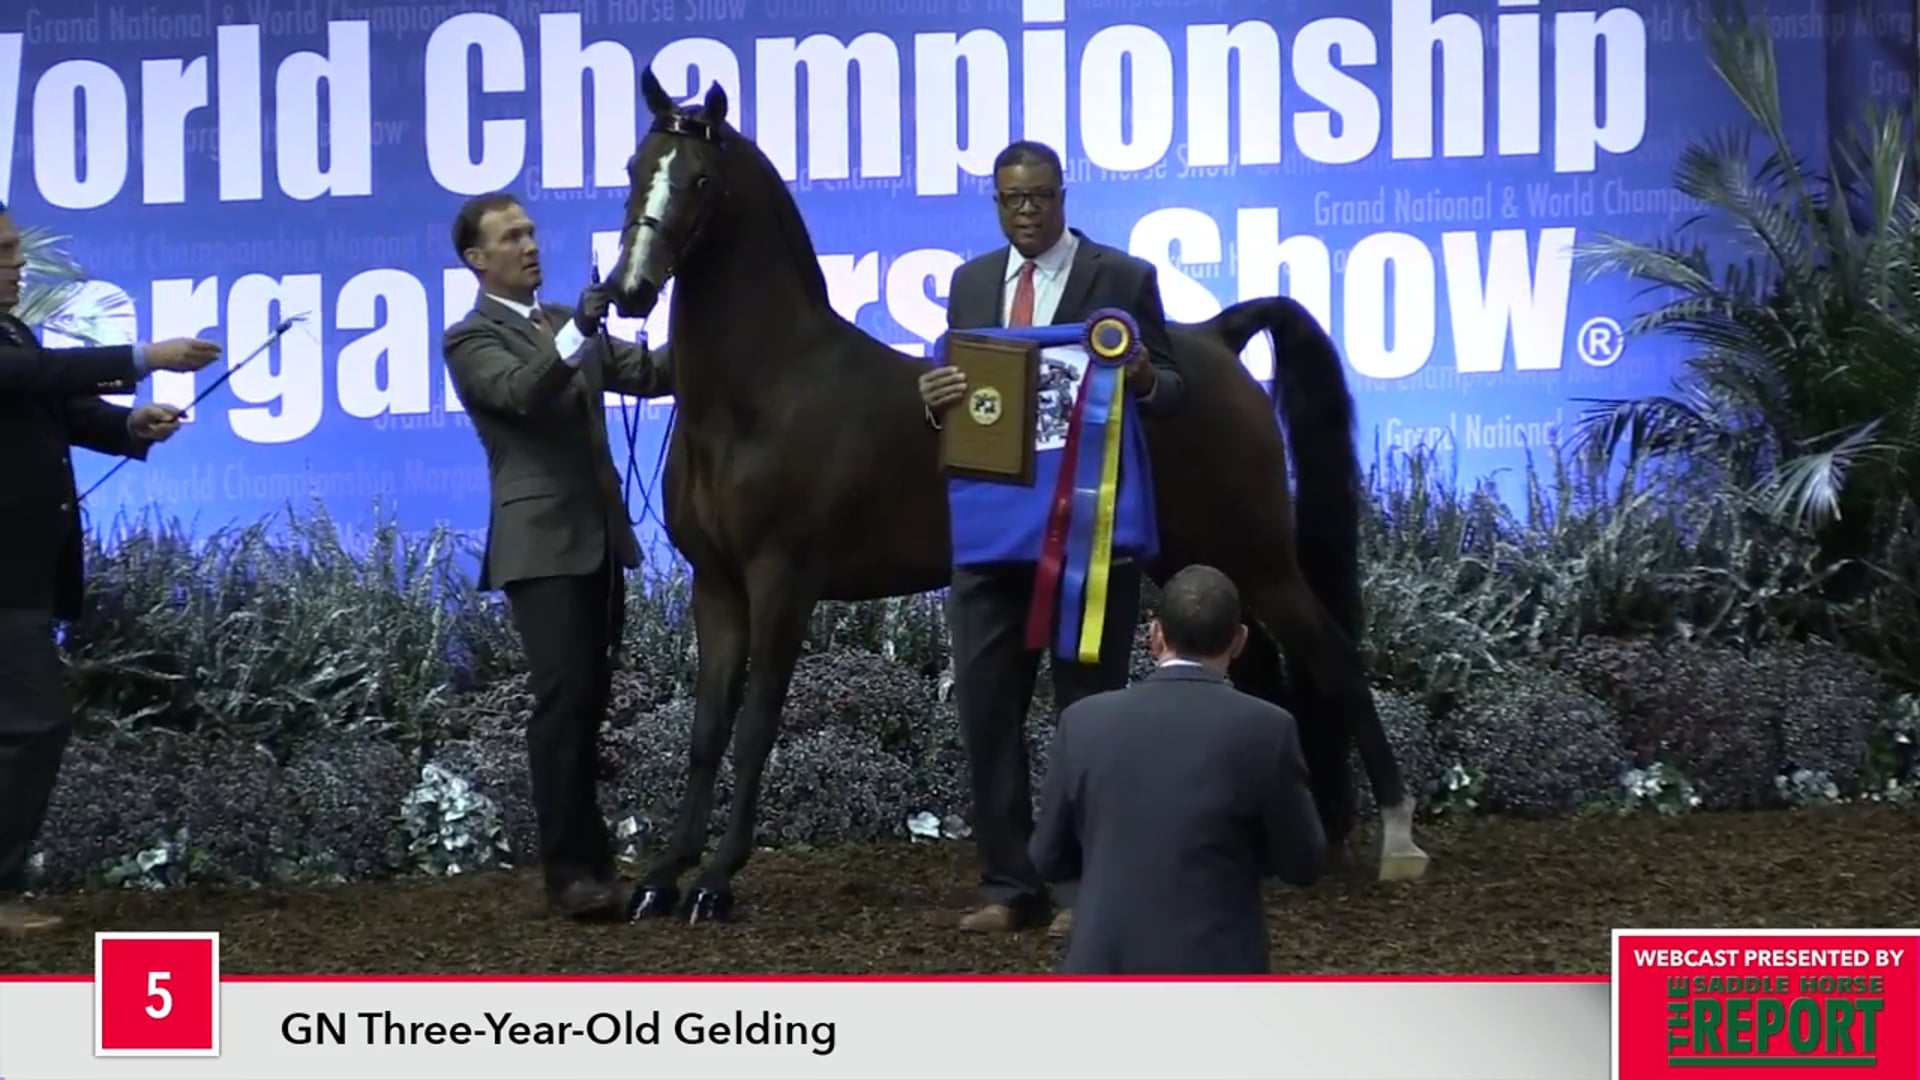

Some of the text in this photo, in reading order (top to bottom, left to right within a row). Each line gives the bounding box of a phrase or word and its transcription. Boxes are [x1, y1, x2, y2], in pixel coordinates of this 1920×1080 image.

[26, 3, 99, 44] Grand
[108, 3, 211, 41] National
[1313, 184, 1385, 227] Grand
[1394, 181, 1492, 225] National
[1501, 185, 1520, 220] &
[1526, 177, 1595, 219] World
[1128, 207, 1577, 380] Show
